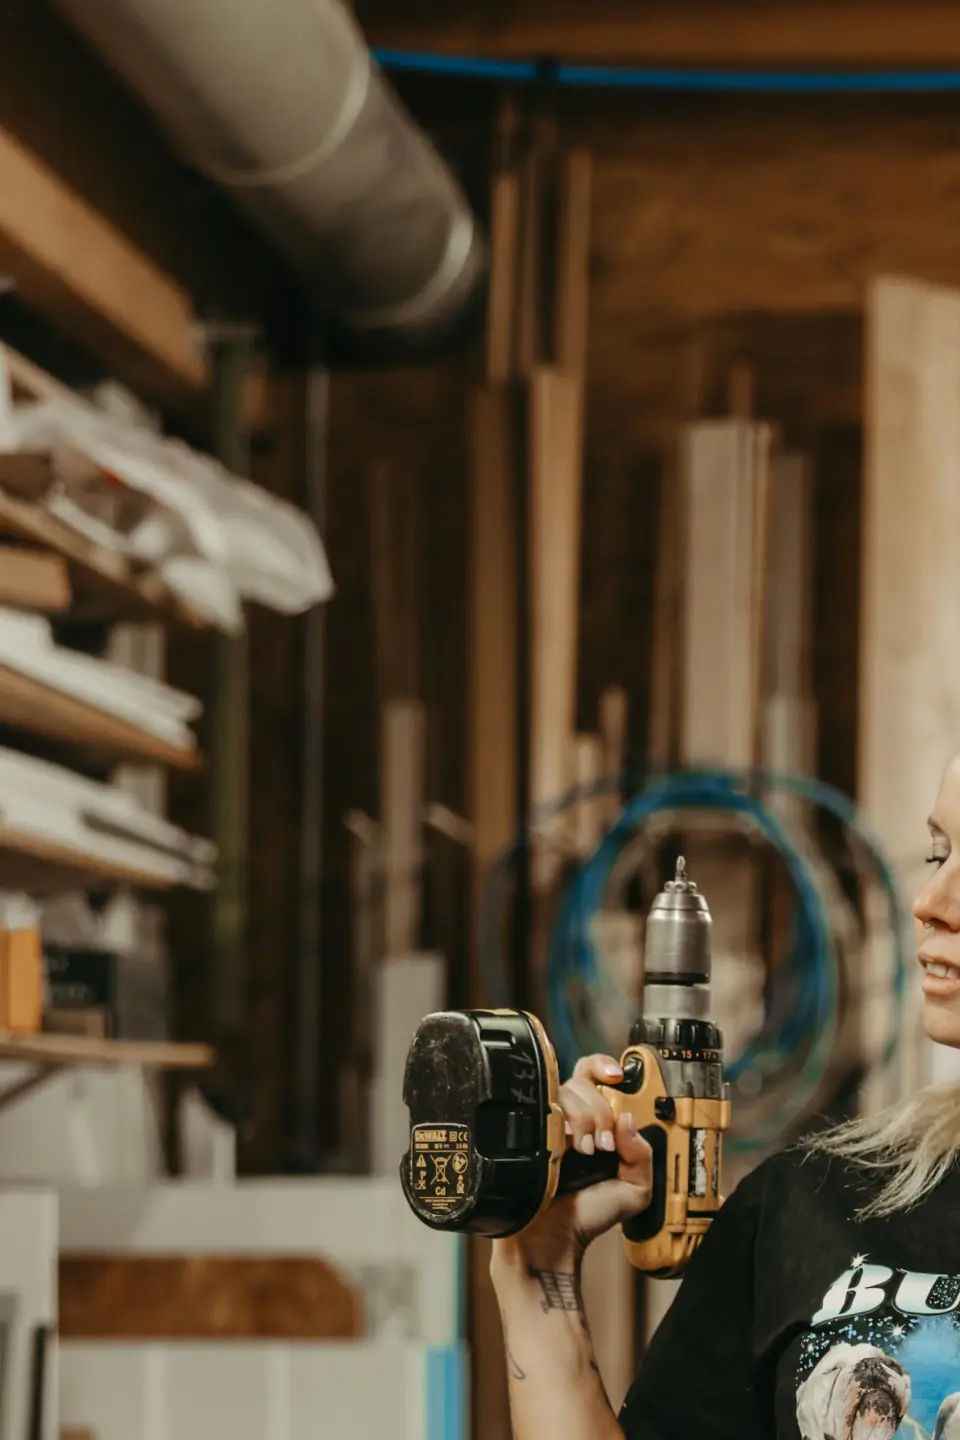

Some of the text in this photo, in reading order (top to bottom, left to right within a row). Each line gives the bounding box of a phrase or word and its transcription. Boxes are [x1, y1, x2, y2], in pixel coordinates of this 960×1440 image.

[658, 1049, 669, 1058] 13
[681, 1050, 692, 1058] 15
[435, 1186, 446, 1196] Cd
